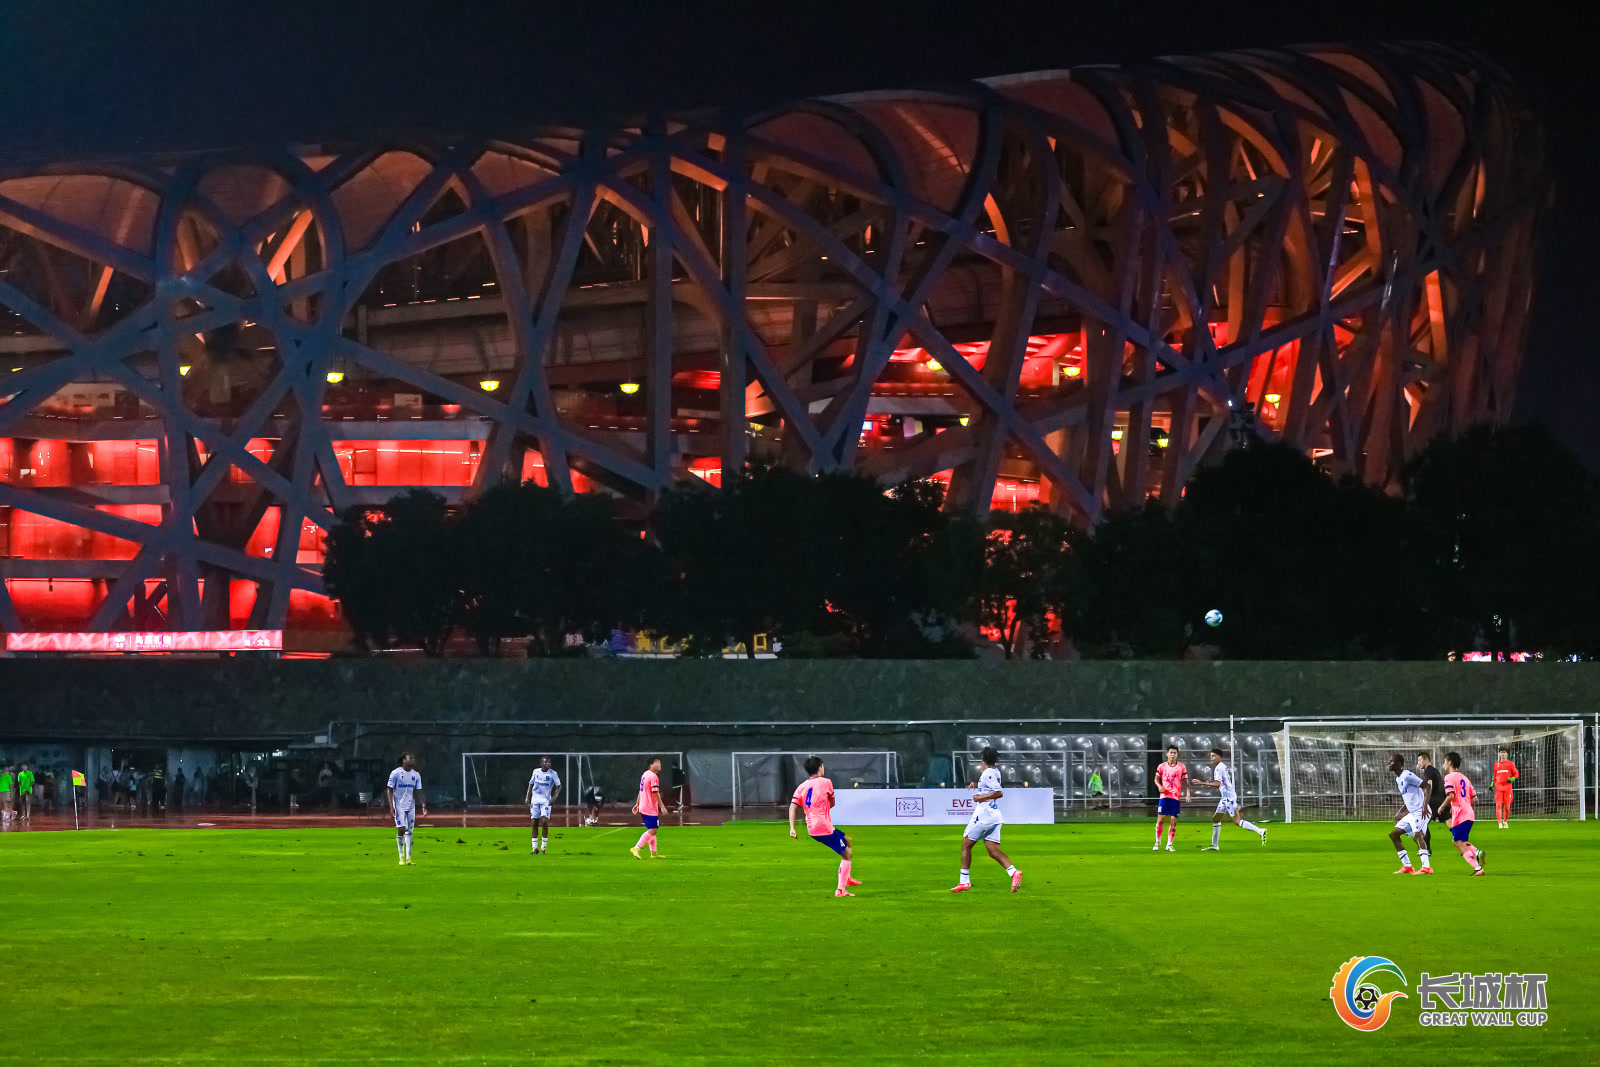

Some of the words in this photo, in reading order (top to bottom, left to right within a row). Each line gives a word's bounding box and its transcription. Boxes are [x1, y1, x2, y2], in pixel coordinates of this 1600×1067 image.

[805, 787, 813, 808] 4
[1460, 779, 1467, 798] 3
[953, 799, 973, 807] EVE
